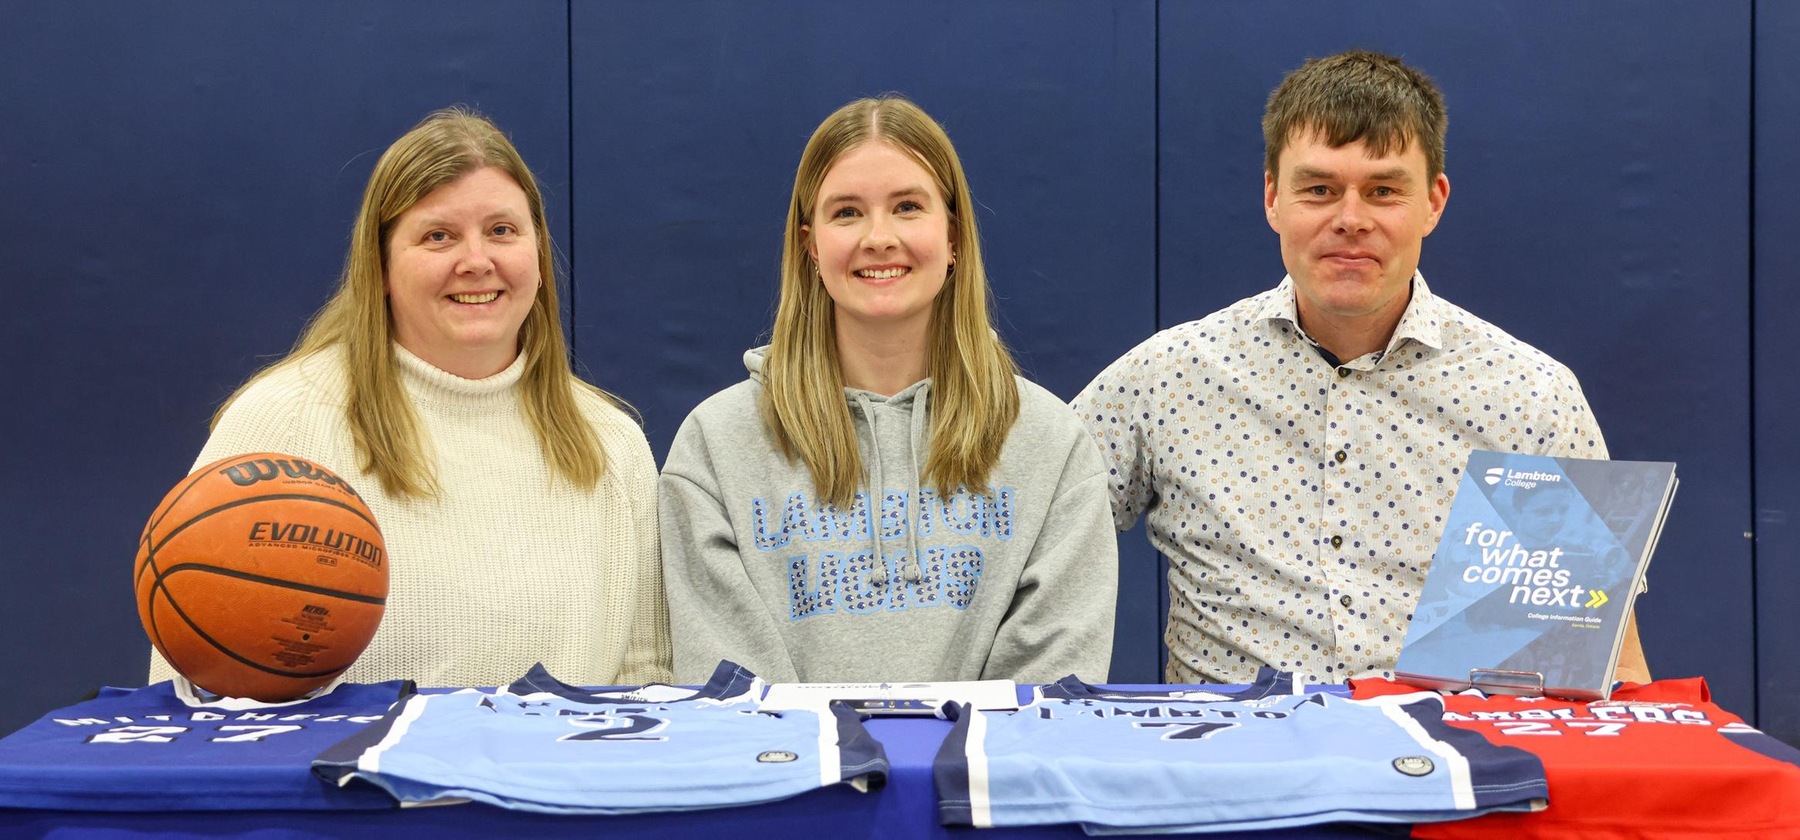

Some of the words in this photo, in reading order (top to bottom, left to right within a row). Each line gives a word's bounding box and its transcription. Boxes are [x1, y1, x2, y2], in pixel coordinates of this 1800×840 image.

[219, 458, 362, 499] Wilso
[1505, 478, 1537, 489] College
[1507, 469, 1561, 482] Lambton
[752, 486, 1015, 550] LAMBTON
[248, 522, 382, 566] EVOLUTION
[248, 542, 298, 550] ADVANCED
[1464, 522, 1512, 548] for
[1481, 544, 1564, 569] what
[788, 545, 985, 621] LIONS
[1462, 565, 1571, 587] comes
[1509, 585, 1584, 608] next
[1527, 612, 1549, 620] College
[1550, 614, 1584, 622] Information
[1442, 706, 1712, 726] AMBLERS
[83, 724, 305, 743] 27
[555, 715, 671, 742] 2
[1131, 721, 1242, 742] 7
[1493, 721, 1628, 737] 27
